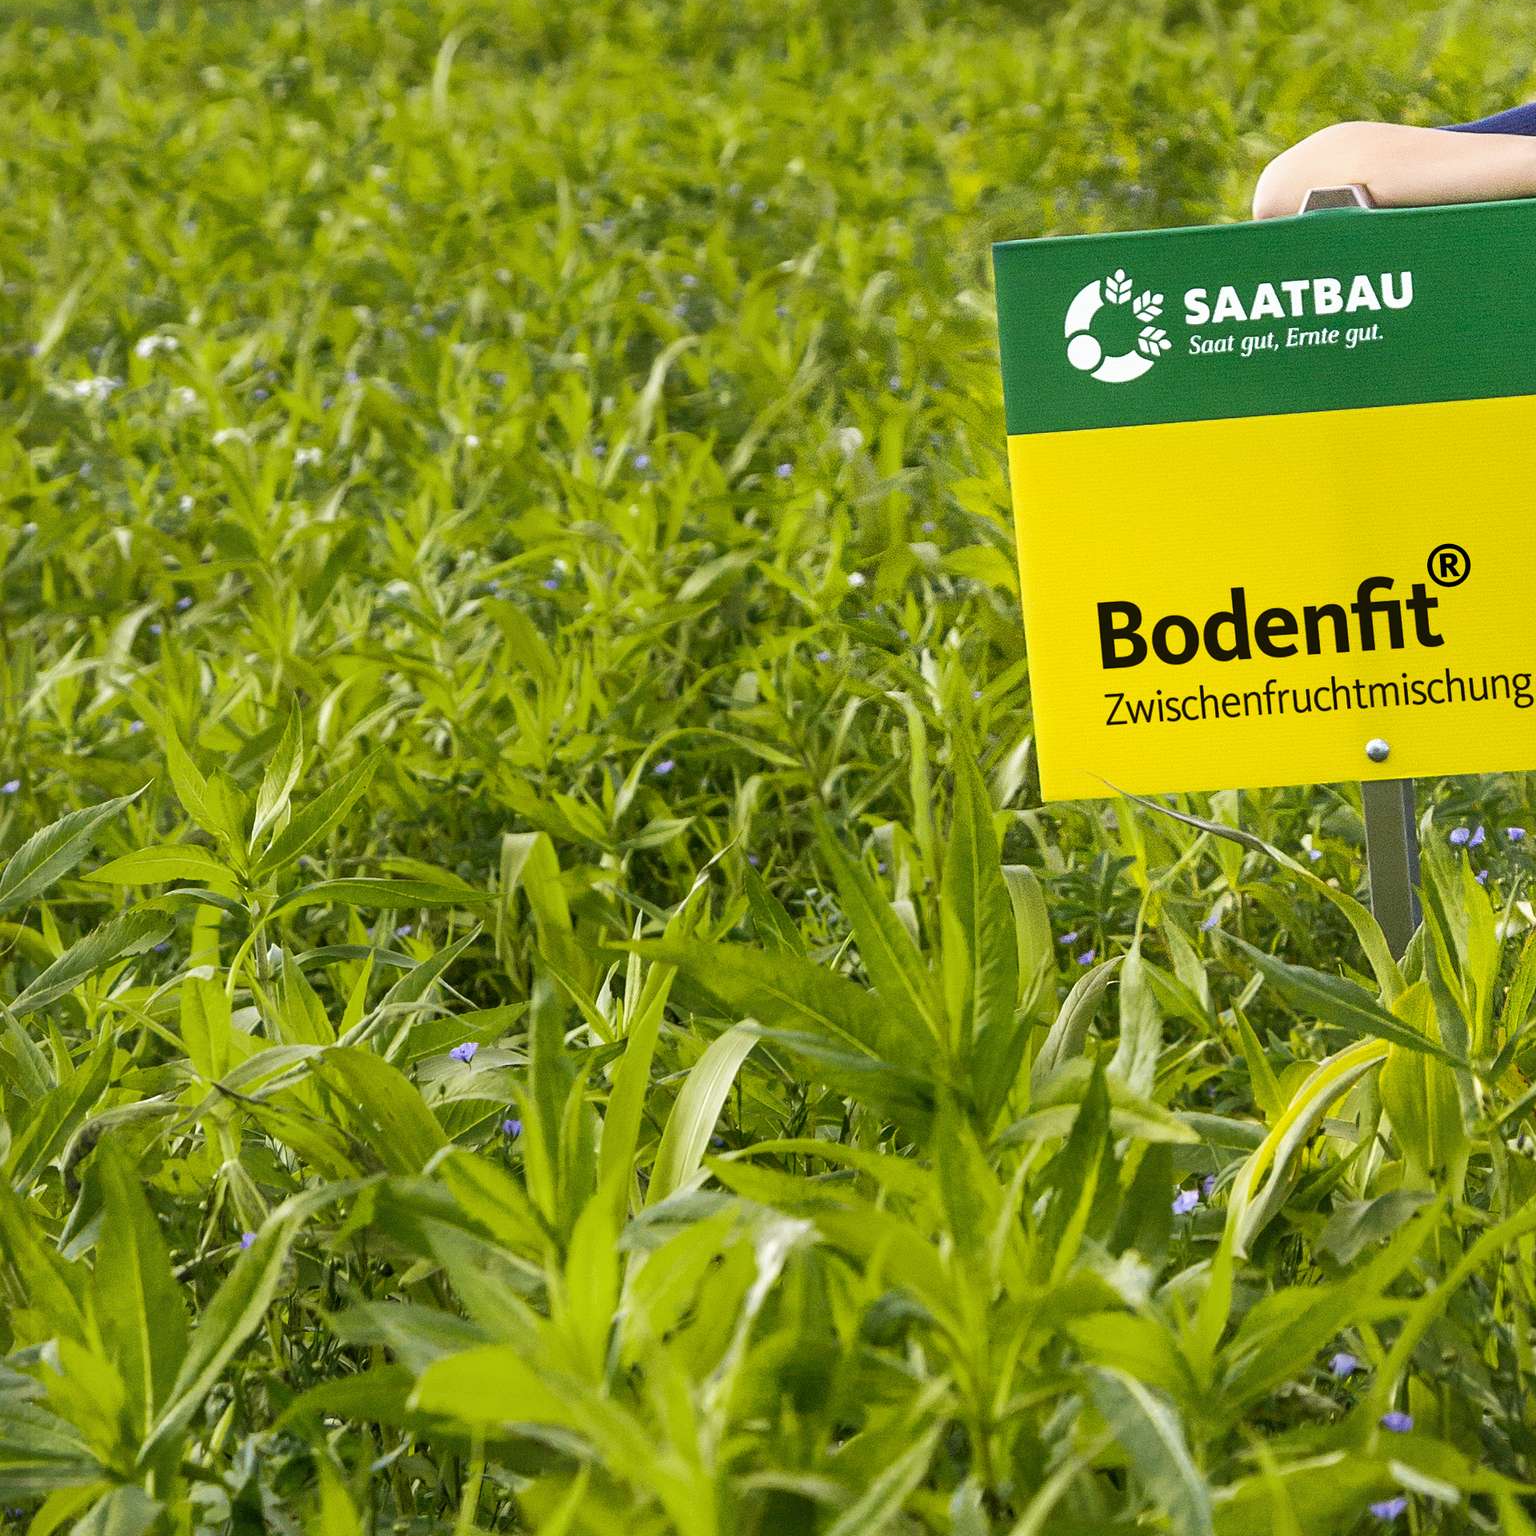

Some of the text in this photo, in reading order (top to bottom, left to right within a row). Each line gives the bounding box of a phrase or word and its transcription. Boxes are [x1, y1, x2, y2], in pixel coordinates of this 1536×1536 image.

[1183, 271, 1414, 326] SAATBAU
[1188, 323, 1384, 357] Saat gut, Ernte gut.
[1104, 667, 1535, 726] Zwischenfruchtmischung
